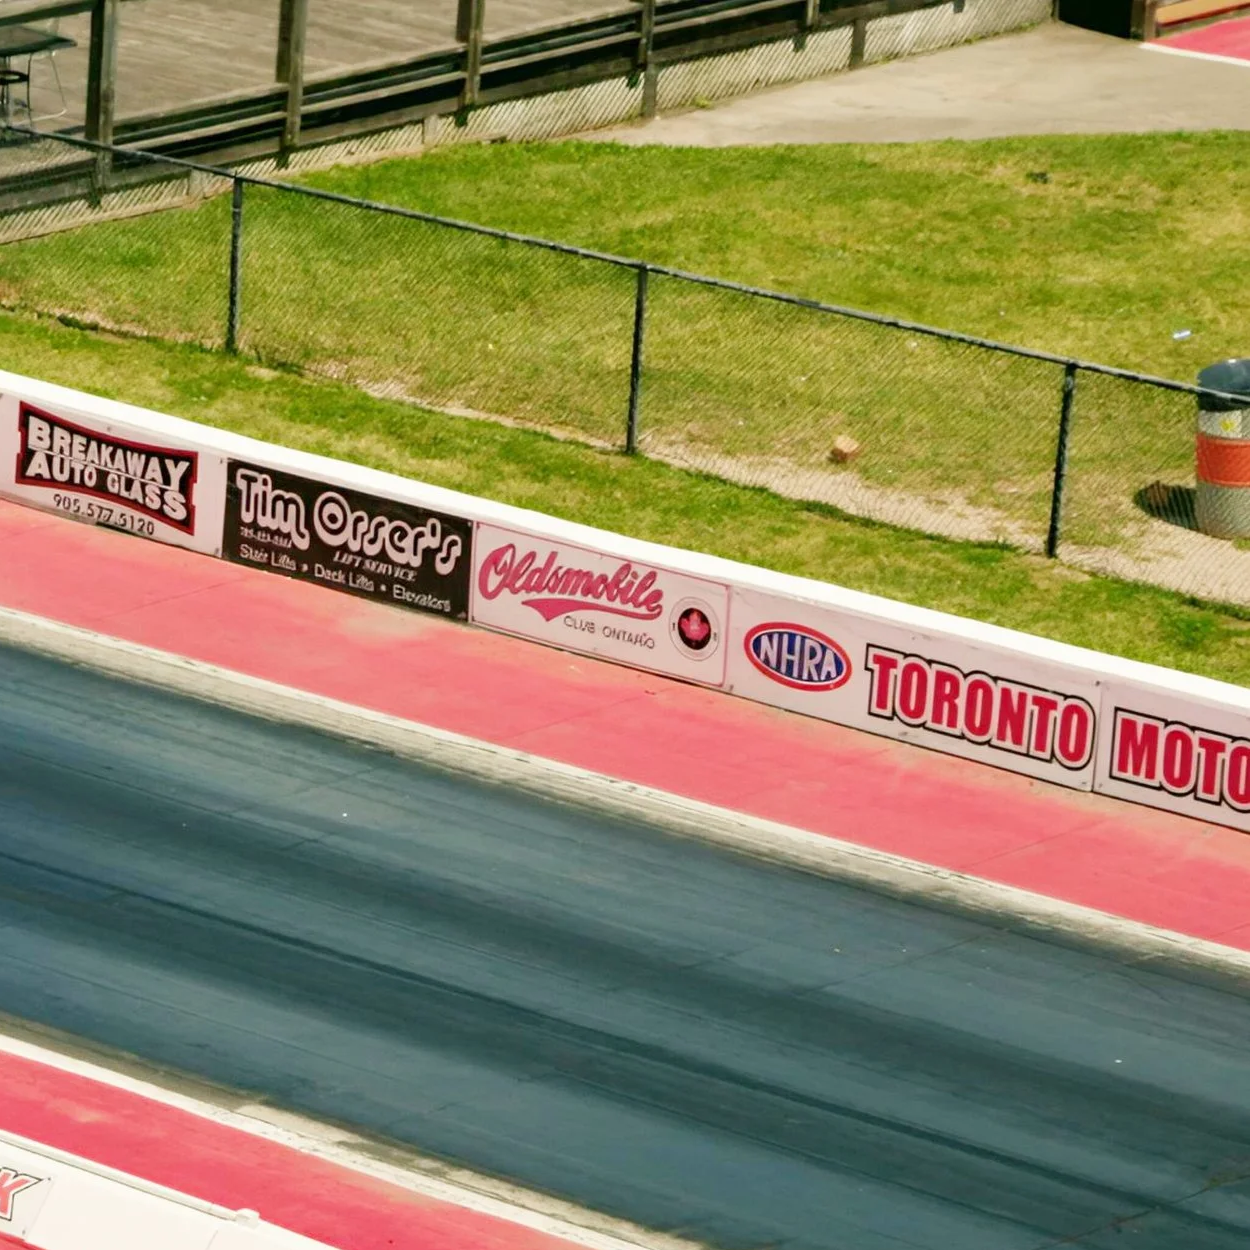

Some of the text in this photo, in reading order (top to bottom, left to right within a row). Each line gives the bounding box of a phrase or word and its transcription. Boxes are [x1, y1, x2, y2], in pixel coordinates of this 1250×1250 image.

[25, 452, 187, 521] AUTO GLASS
[28, 415, 190, 491] BREAKAWAY
[236, 468, 310, 550] Tim
[333, 551, 418, 581] LIFT SERVICE
[393, 584, 451, 612] Elevators
[478, 543, 664, 613] Oldsmobile
[564, 615, 655, 650] CLUB ONTARIO
[760, 632, 837, 682] NHRA
[866, 645, 1250, 812] TORONTO MOTO
